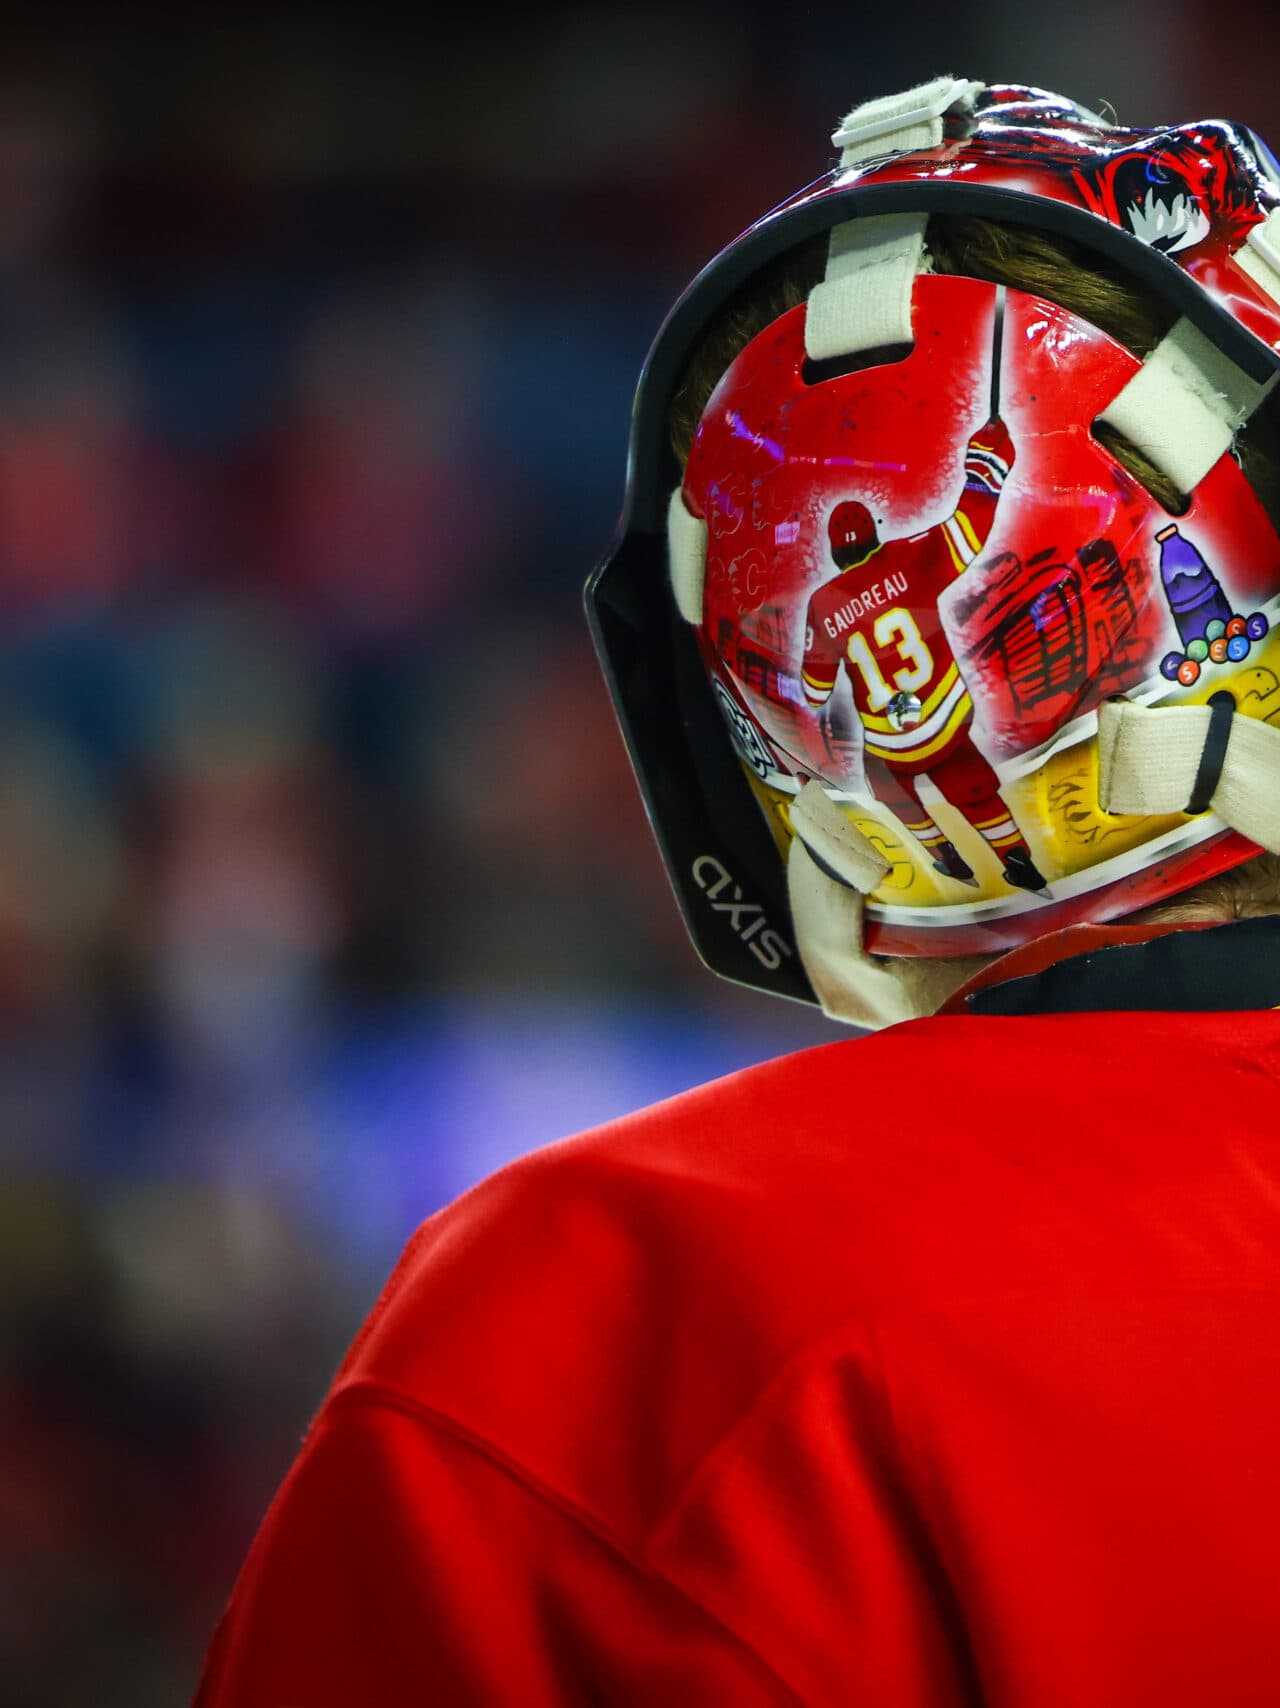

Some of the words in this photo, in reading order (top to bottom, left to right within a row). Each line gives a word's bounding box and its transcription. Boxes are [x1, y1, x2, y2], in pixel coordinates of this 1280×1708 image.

[845, 531, 857, 543] 13
[823, 570, 909, 640] GAUDREAU
[847, 607, 936, 713] 13
